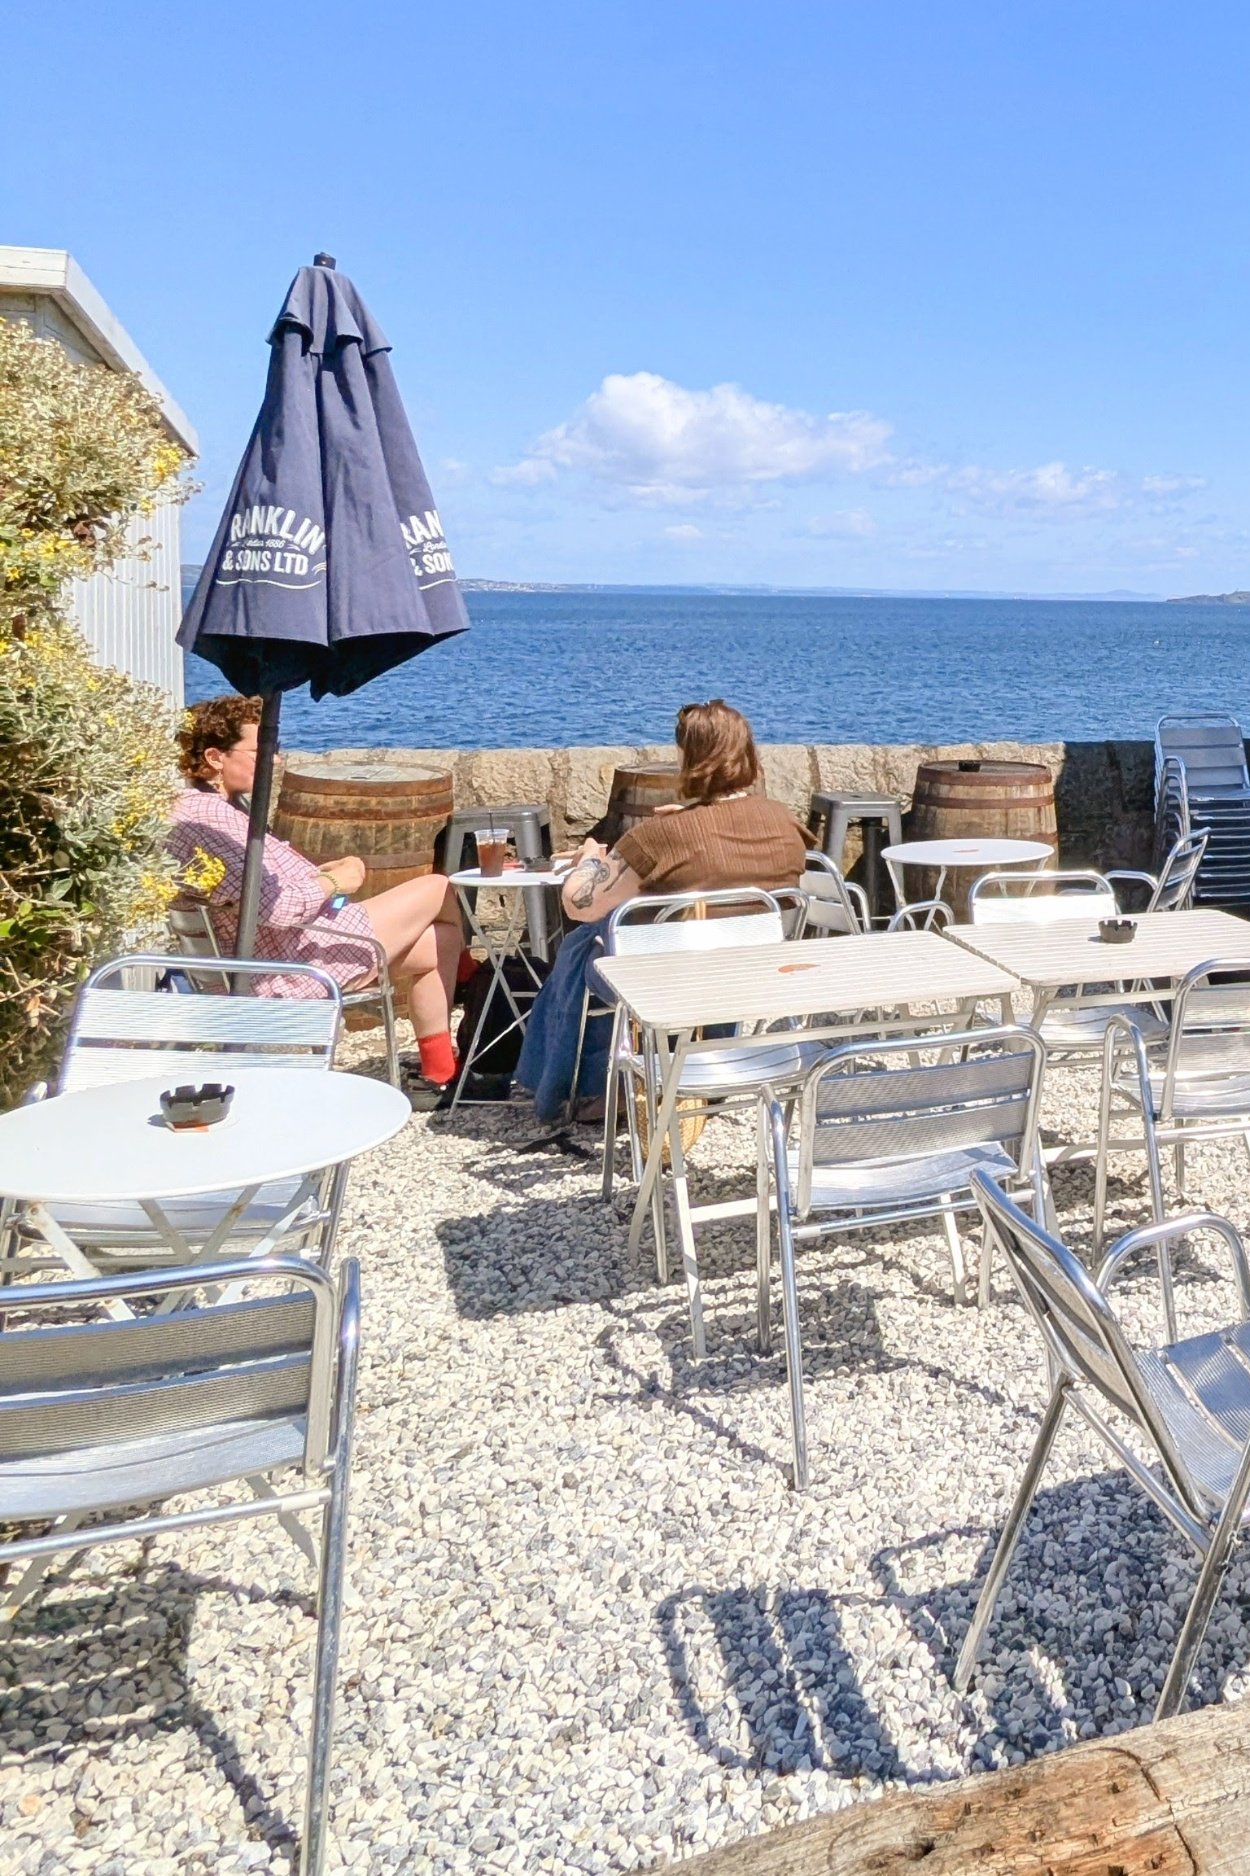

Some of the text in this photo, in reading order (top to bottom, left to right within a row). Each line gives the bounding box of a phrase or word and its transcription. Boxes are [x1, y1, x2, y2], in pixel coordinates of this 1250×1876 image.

[222, 550, 309, 576] & SONS LTD
